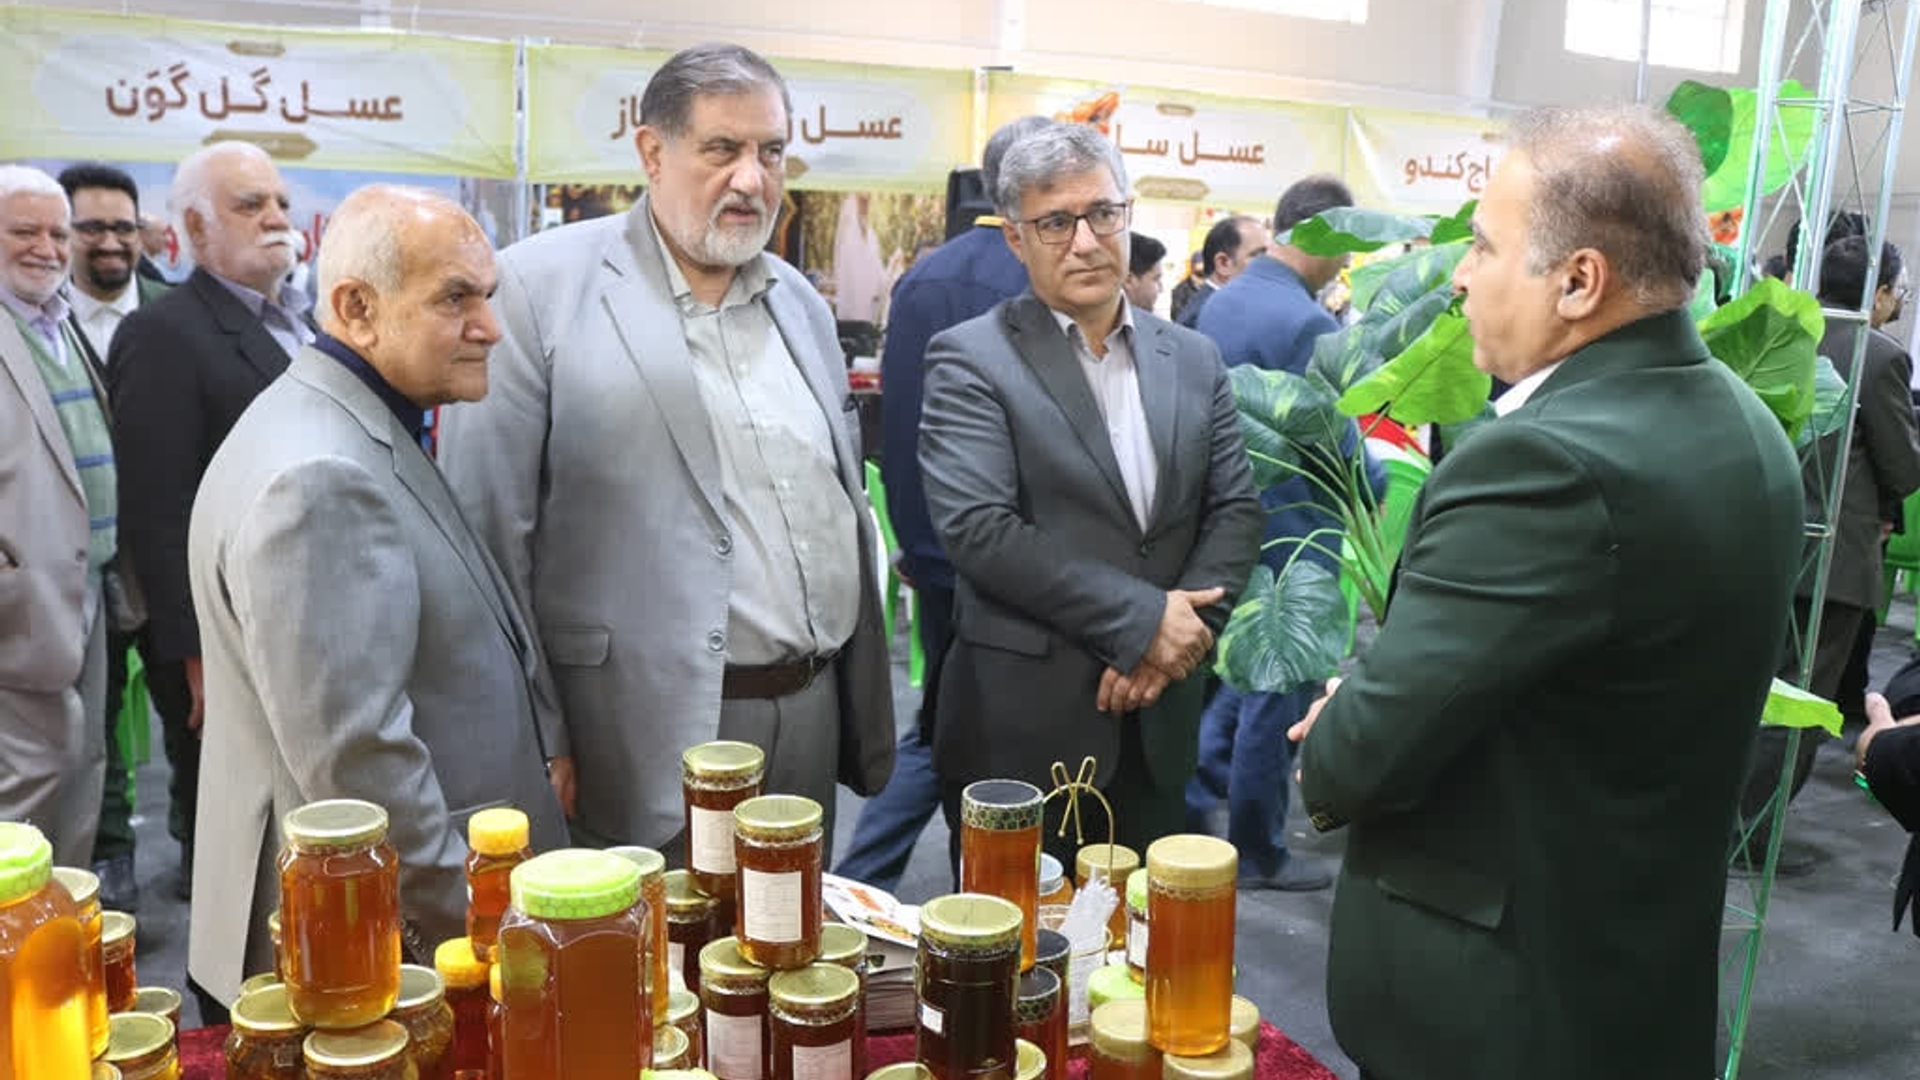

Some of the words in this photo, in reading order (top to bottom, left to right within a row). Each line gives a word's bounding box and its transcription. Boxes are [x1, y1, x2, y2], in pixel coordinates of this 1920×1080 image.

[199, 66, 271, 120] گل
[280, 80, 403, 123] عسل
[801, 104, 902, 145] عسل
[1115, 122, 1169, 157] سا
[1179, 130, 1265, 166] عسل
[1404, 150, 1468, 185] کندو
